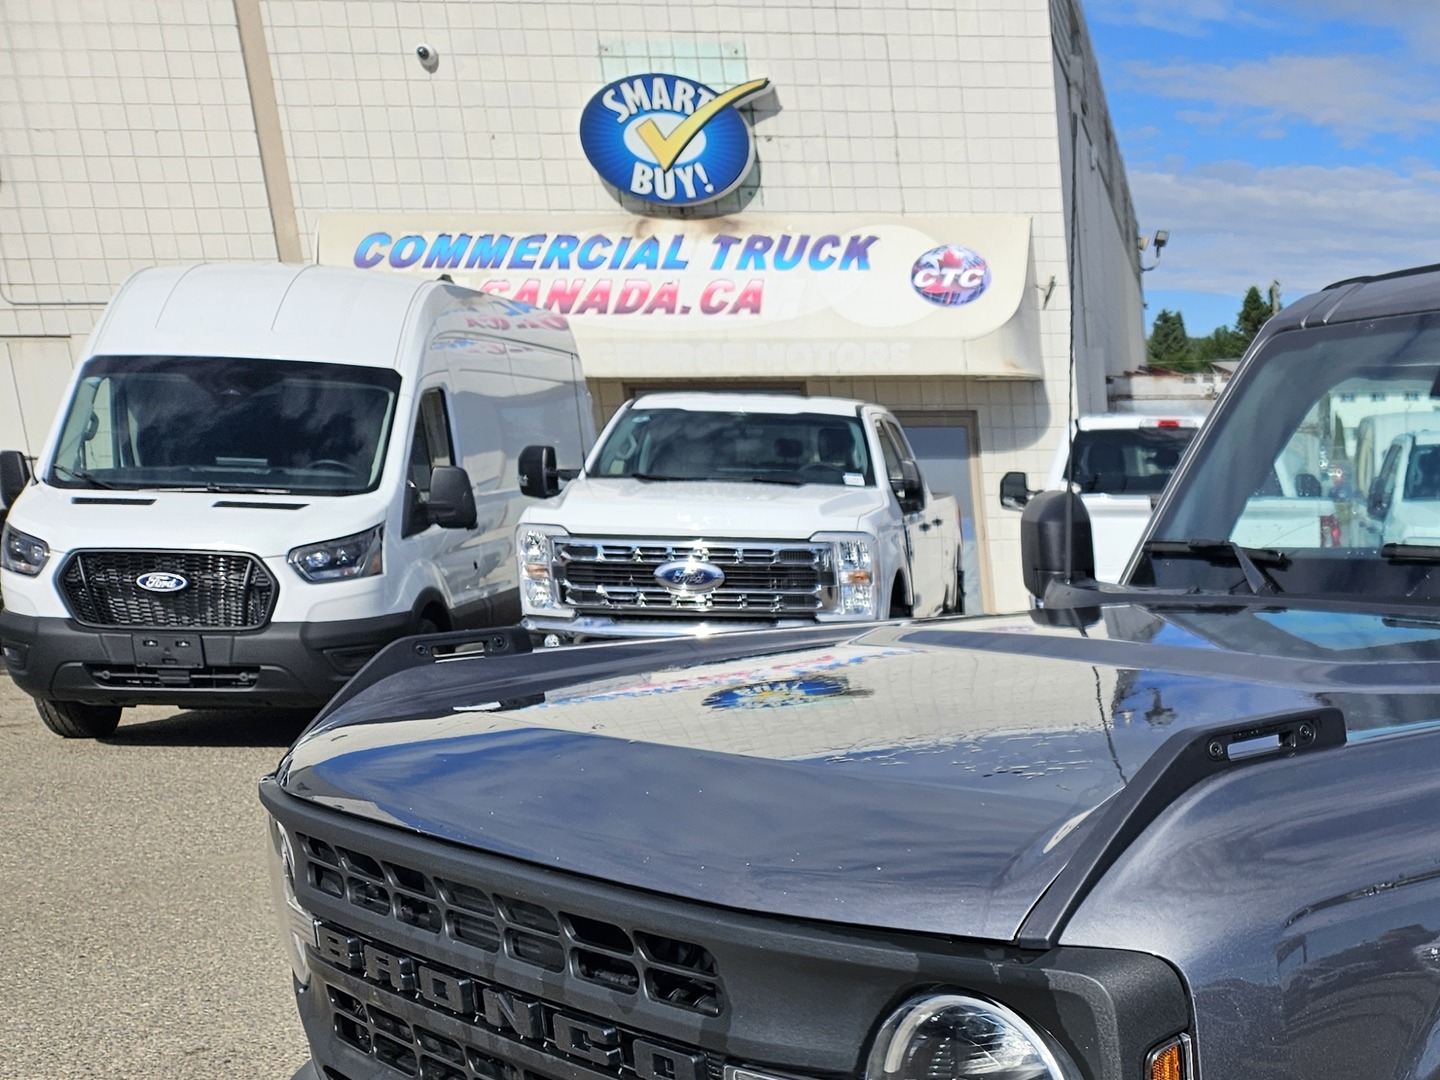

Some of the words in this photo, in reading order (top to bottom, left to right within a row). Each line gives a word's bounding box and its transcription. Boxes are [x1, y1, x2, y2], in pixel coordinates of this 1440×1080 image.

[602, 77, 716, 124] SMART
[630, 161, 714, 200] BUY!
[353, 232, 689, 270] COMMERCIAL
[710, 234, 880, 271] TRUCK
[913, 267, 987, 288] CTC
